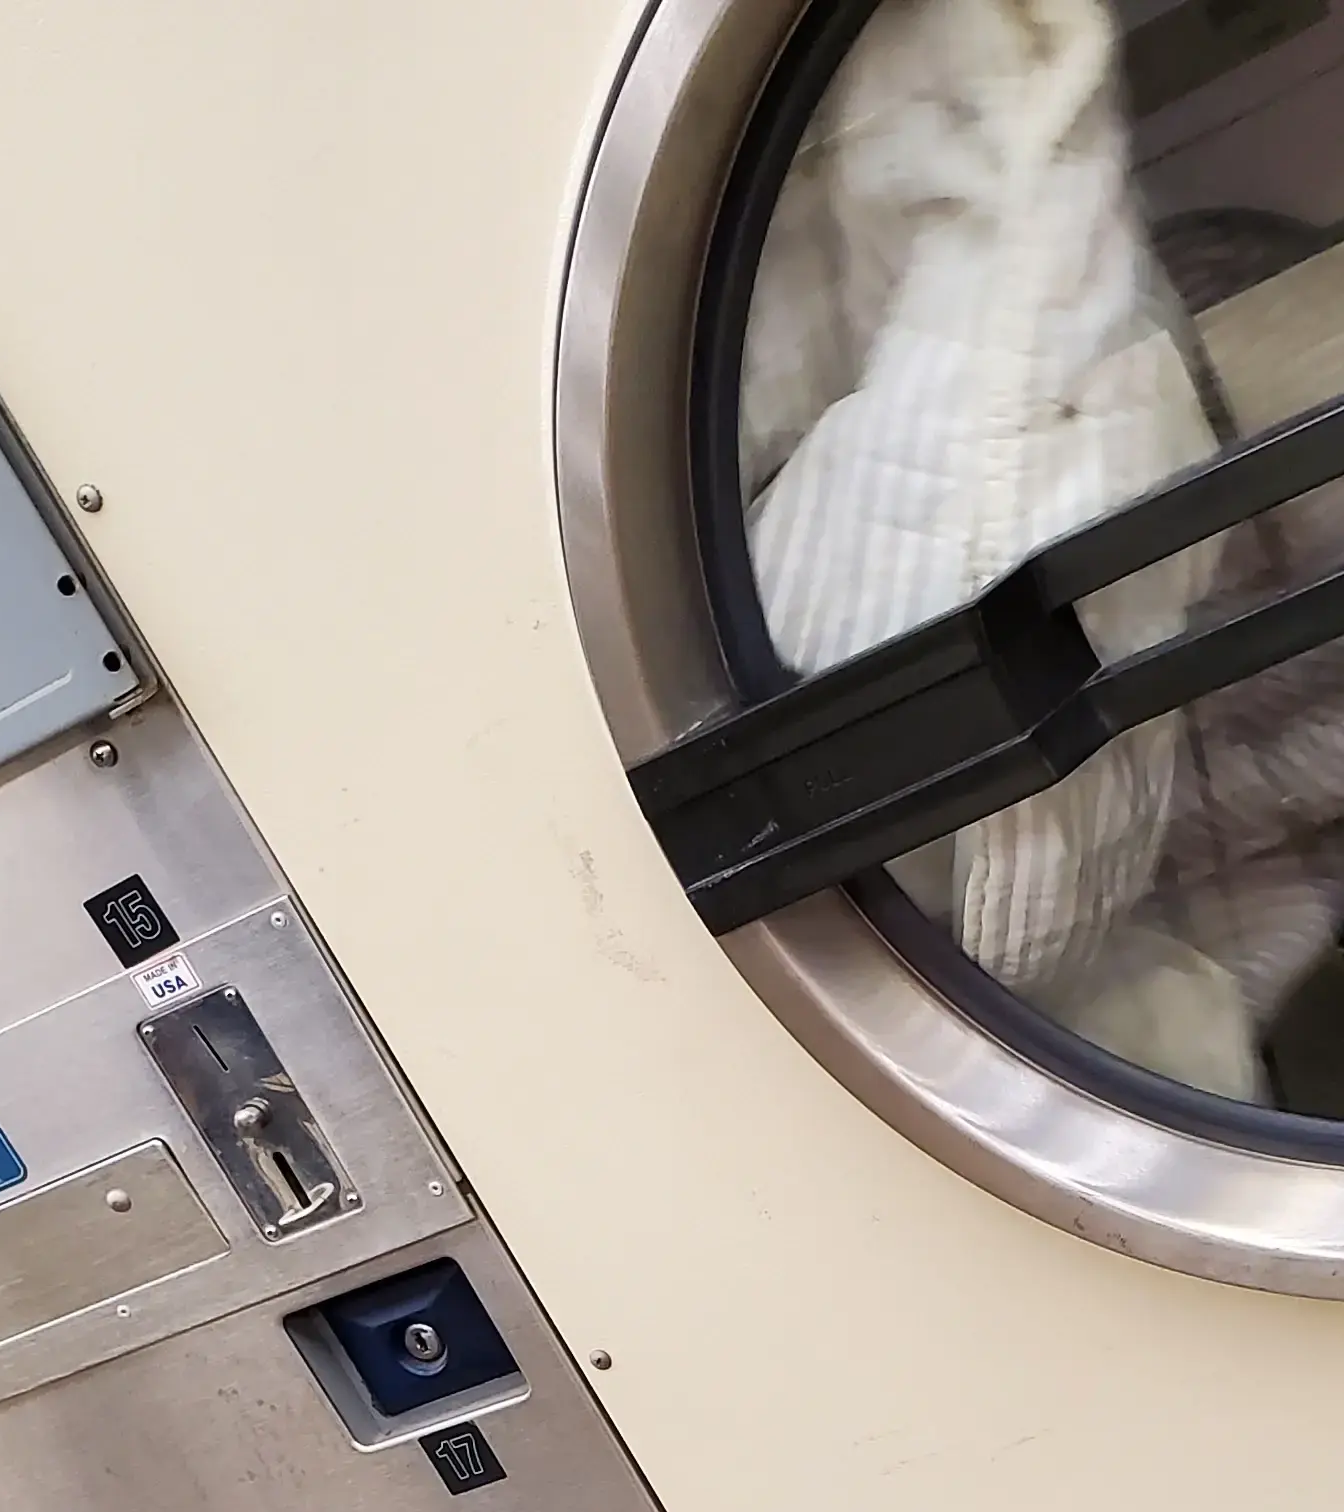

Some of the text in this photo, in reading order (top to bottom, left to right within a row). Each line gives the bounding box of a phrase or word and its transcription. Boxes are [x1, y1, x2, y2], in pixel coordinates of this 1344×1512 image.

[102, 889, 161, 948] 15
[143, 961, 178, 982] MADE IN
[151, 975, 188, 998] USA
[435, 1433, 484, 1480] 17
